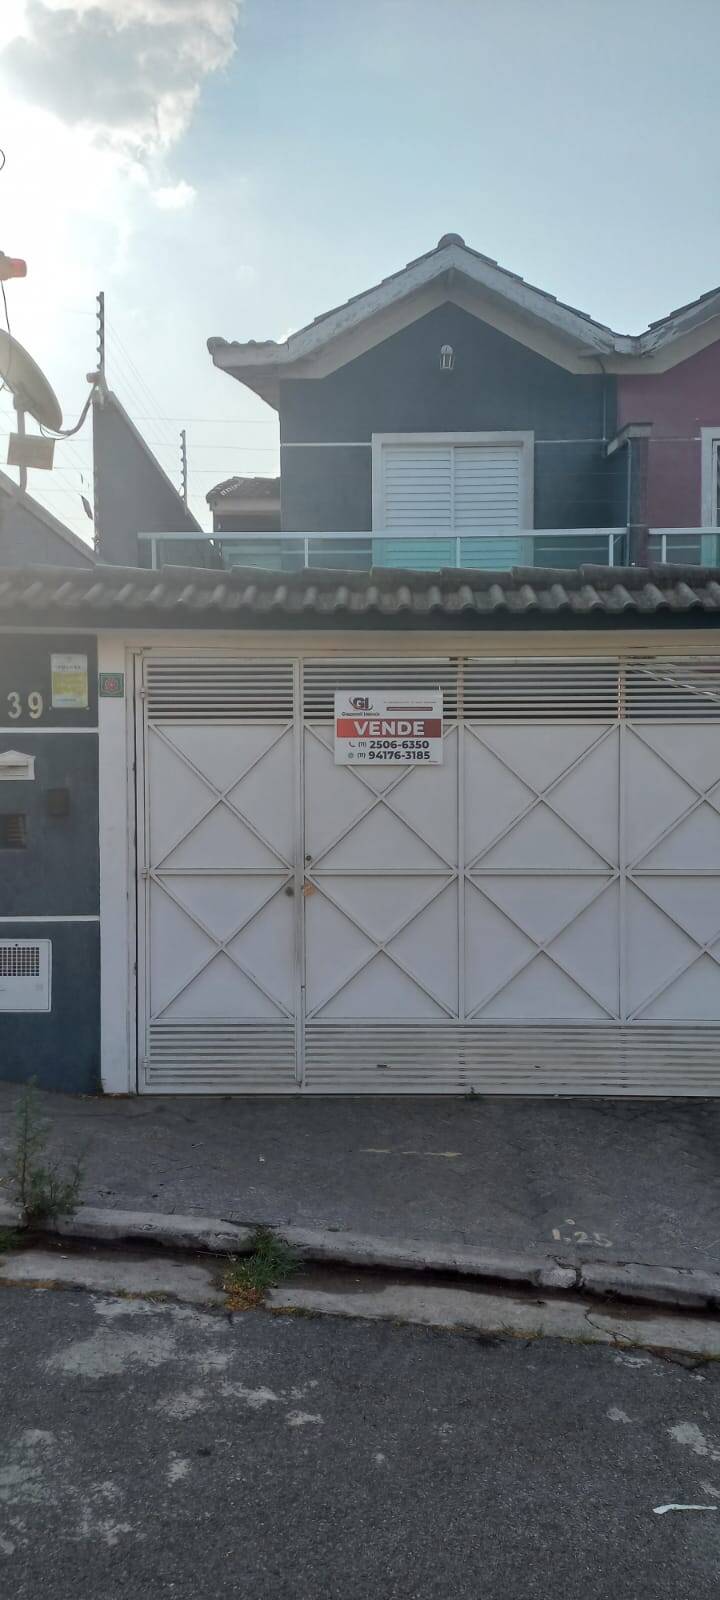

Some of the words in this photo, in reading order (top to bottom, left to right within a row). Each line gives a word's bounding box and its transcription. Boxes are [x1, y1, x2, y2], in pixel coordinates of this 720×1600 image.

[7, 691, 43, 719] 39
[354, 720, 425, 736] VENDE
[370, 740, 430, 749] 2506-6350
[368, 751, 431, 760] 94176-3185
